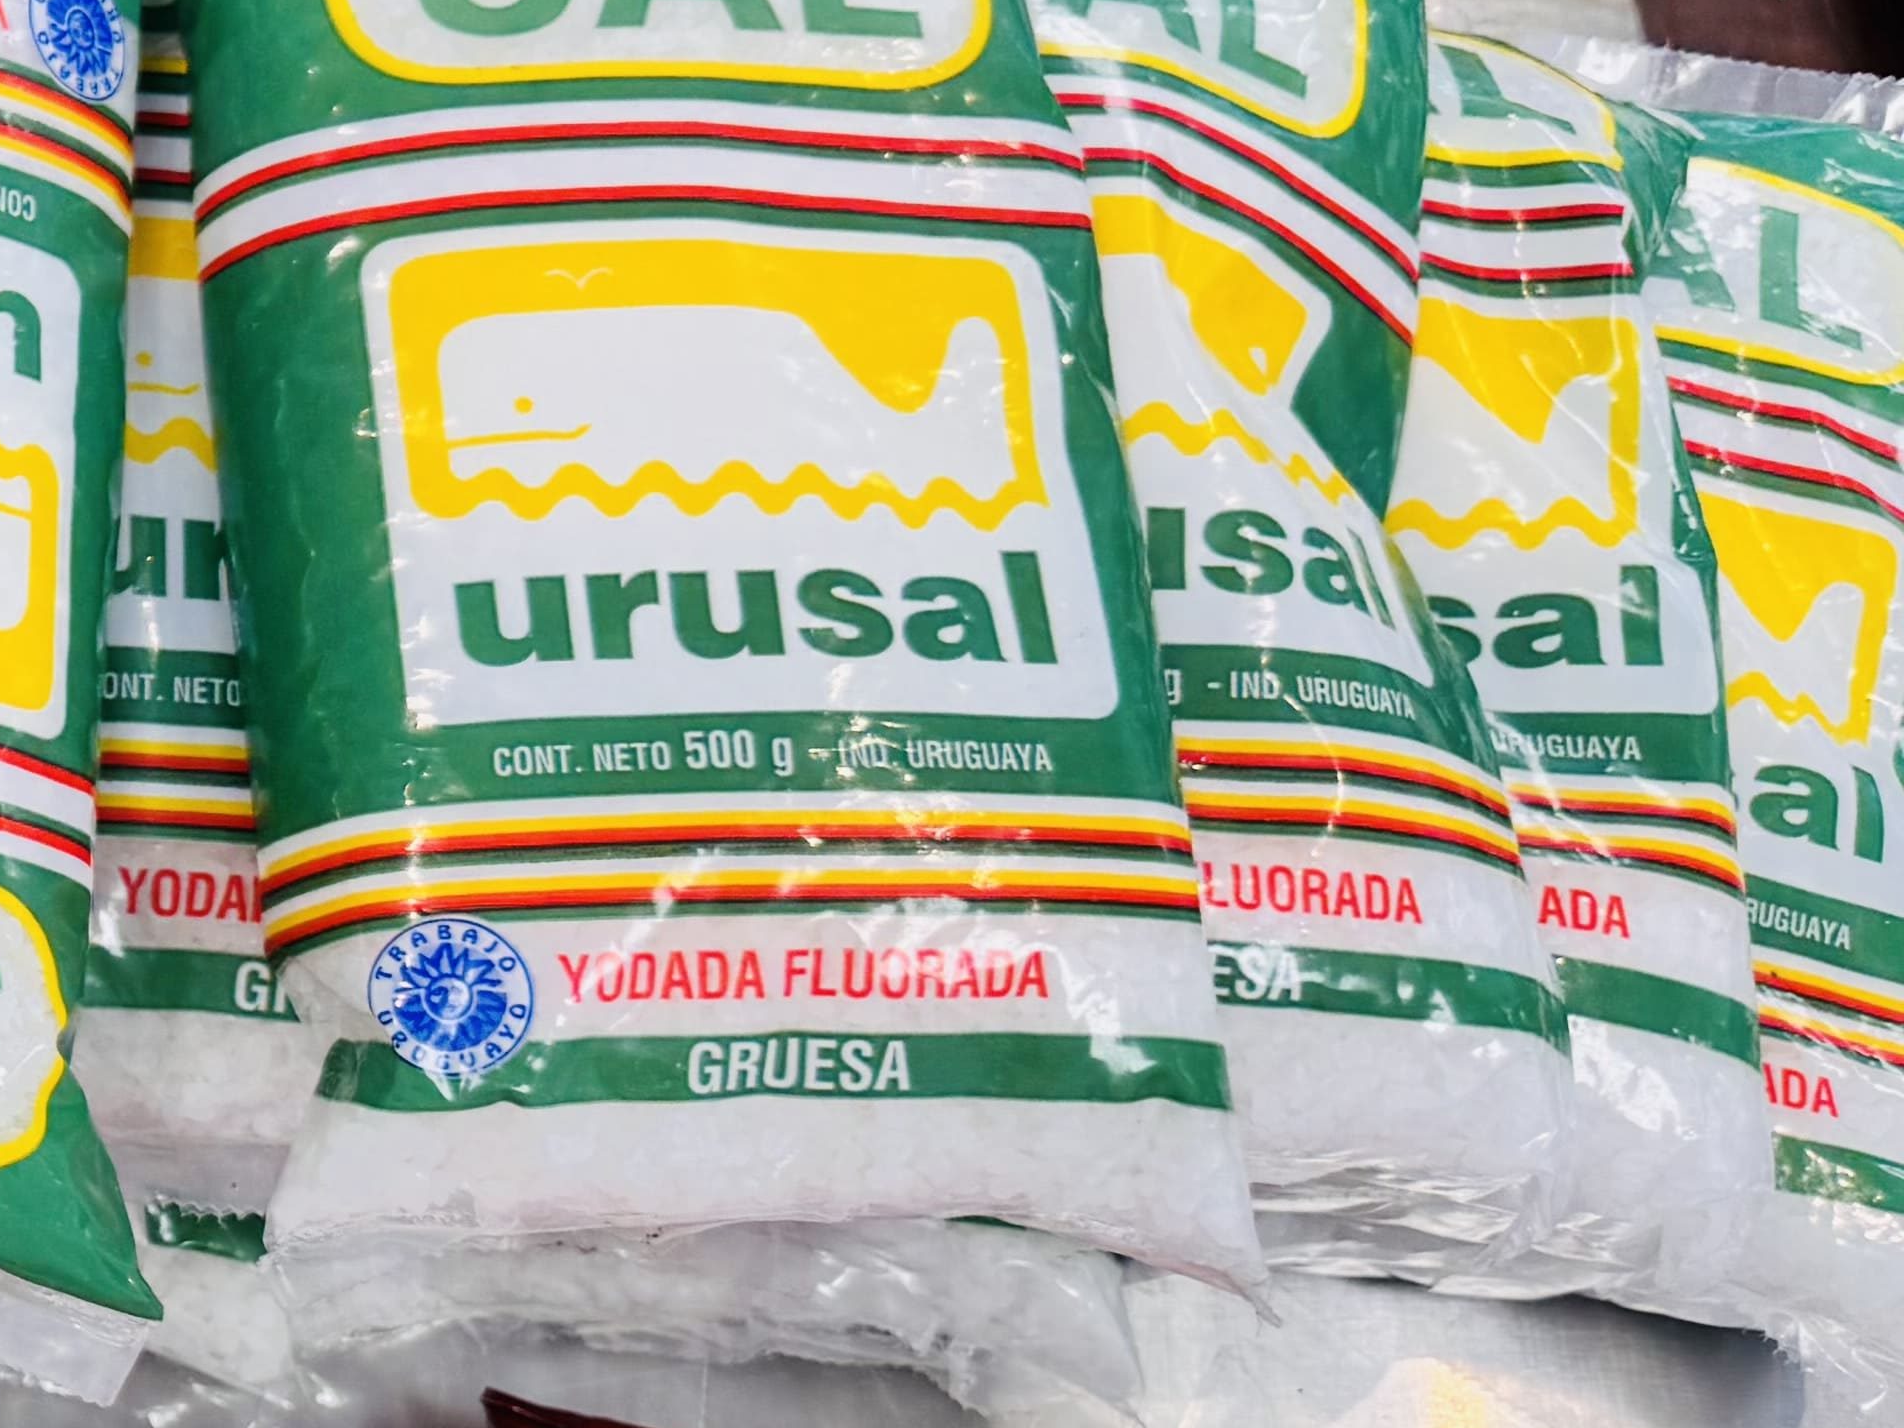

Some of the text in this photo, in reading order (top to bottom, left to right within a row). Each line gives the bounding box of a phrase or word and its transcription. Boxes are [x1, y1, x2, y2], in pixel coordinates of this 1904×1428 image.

[454, 549, 1062, 668] urusal
[174, 673, 241, 709] NETO
[1229, 671, 1415, 721] IND. URUGUAYA
[493, 729, 1054, 779] CONT. NETO 500 g URUGUAYA
[557, 948, 1051, 1004] YODADA FLUORADA
[687, 1038, 912, 1096] GRUESA
